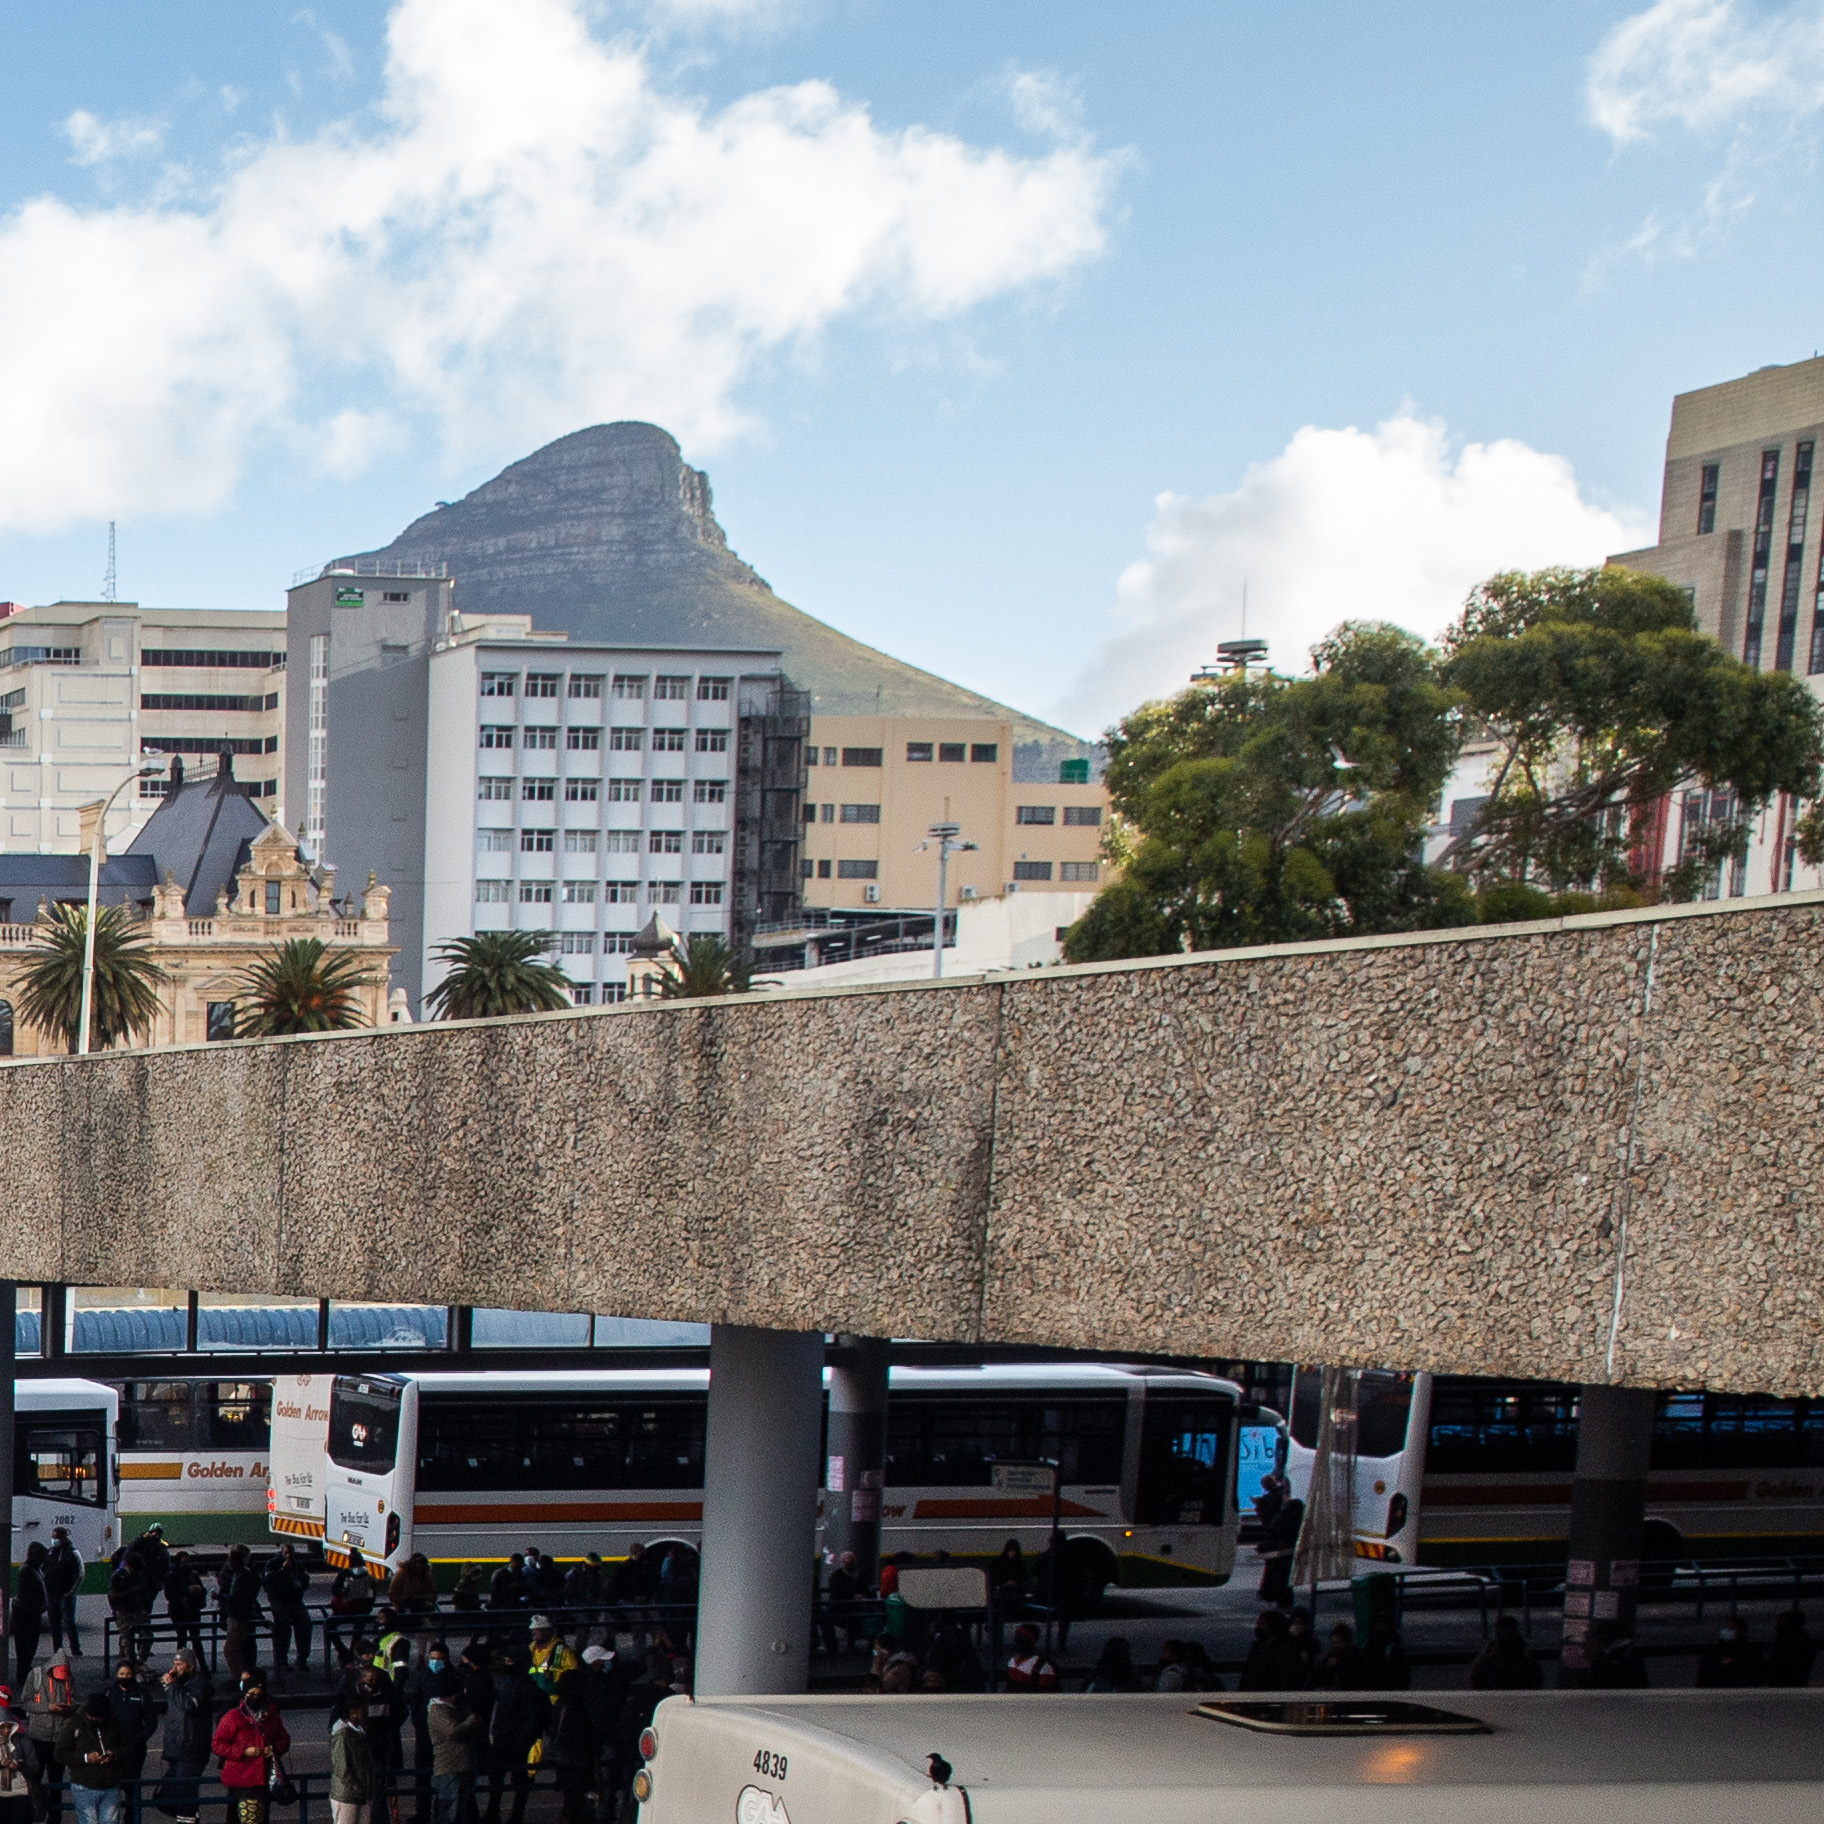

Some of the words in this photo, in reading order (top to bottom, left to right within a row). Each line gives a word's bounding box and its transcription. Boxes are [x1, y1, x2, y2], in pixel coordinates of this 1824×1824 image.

[276, 1401, 302, 1420] Golden
[187, 1462, 244, 1478] Golden
[753, 1749, 788, 1780] 4839
